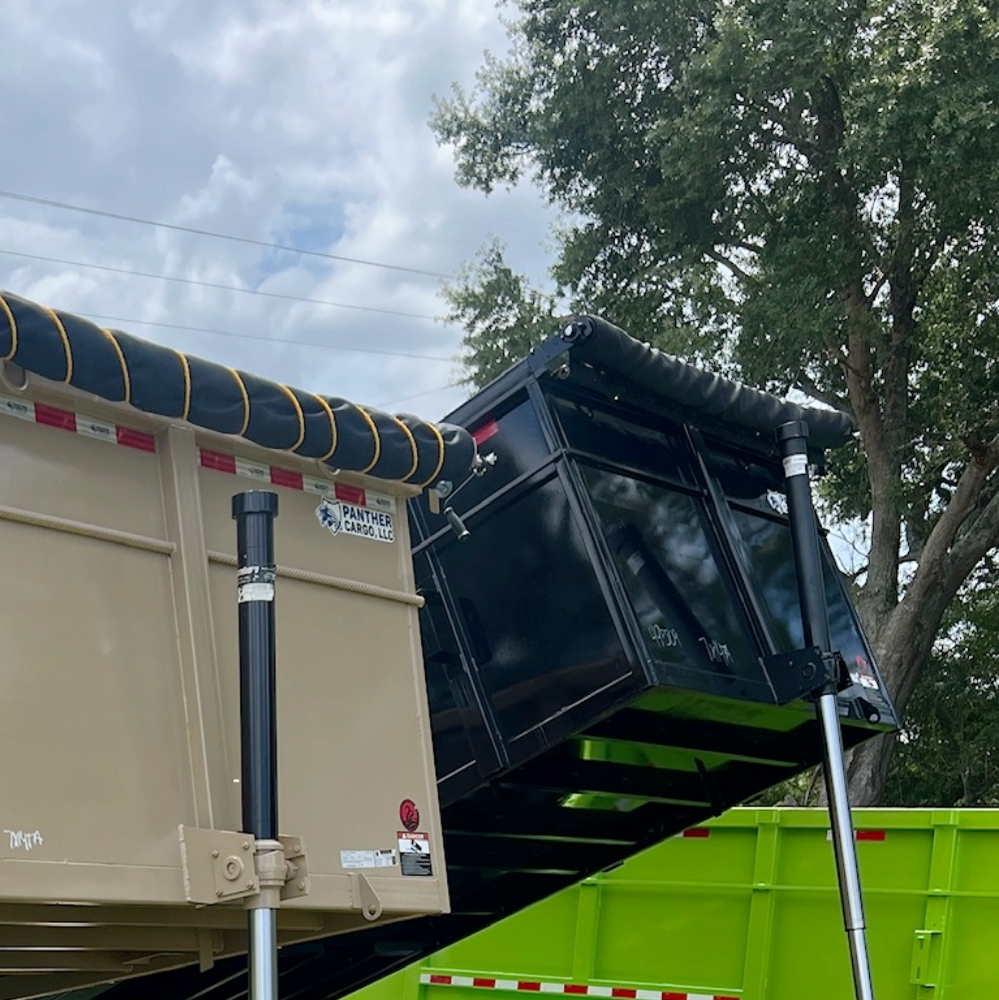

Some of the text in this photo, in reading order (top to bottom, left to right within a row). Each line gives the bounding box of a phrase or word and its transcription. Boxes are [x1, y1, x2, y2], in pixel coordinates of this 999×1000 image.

[342, 504, 393, 528] PANTHER
[344, 520, 394, 541] CARGO, LLC
